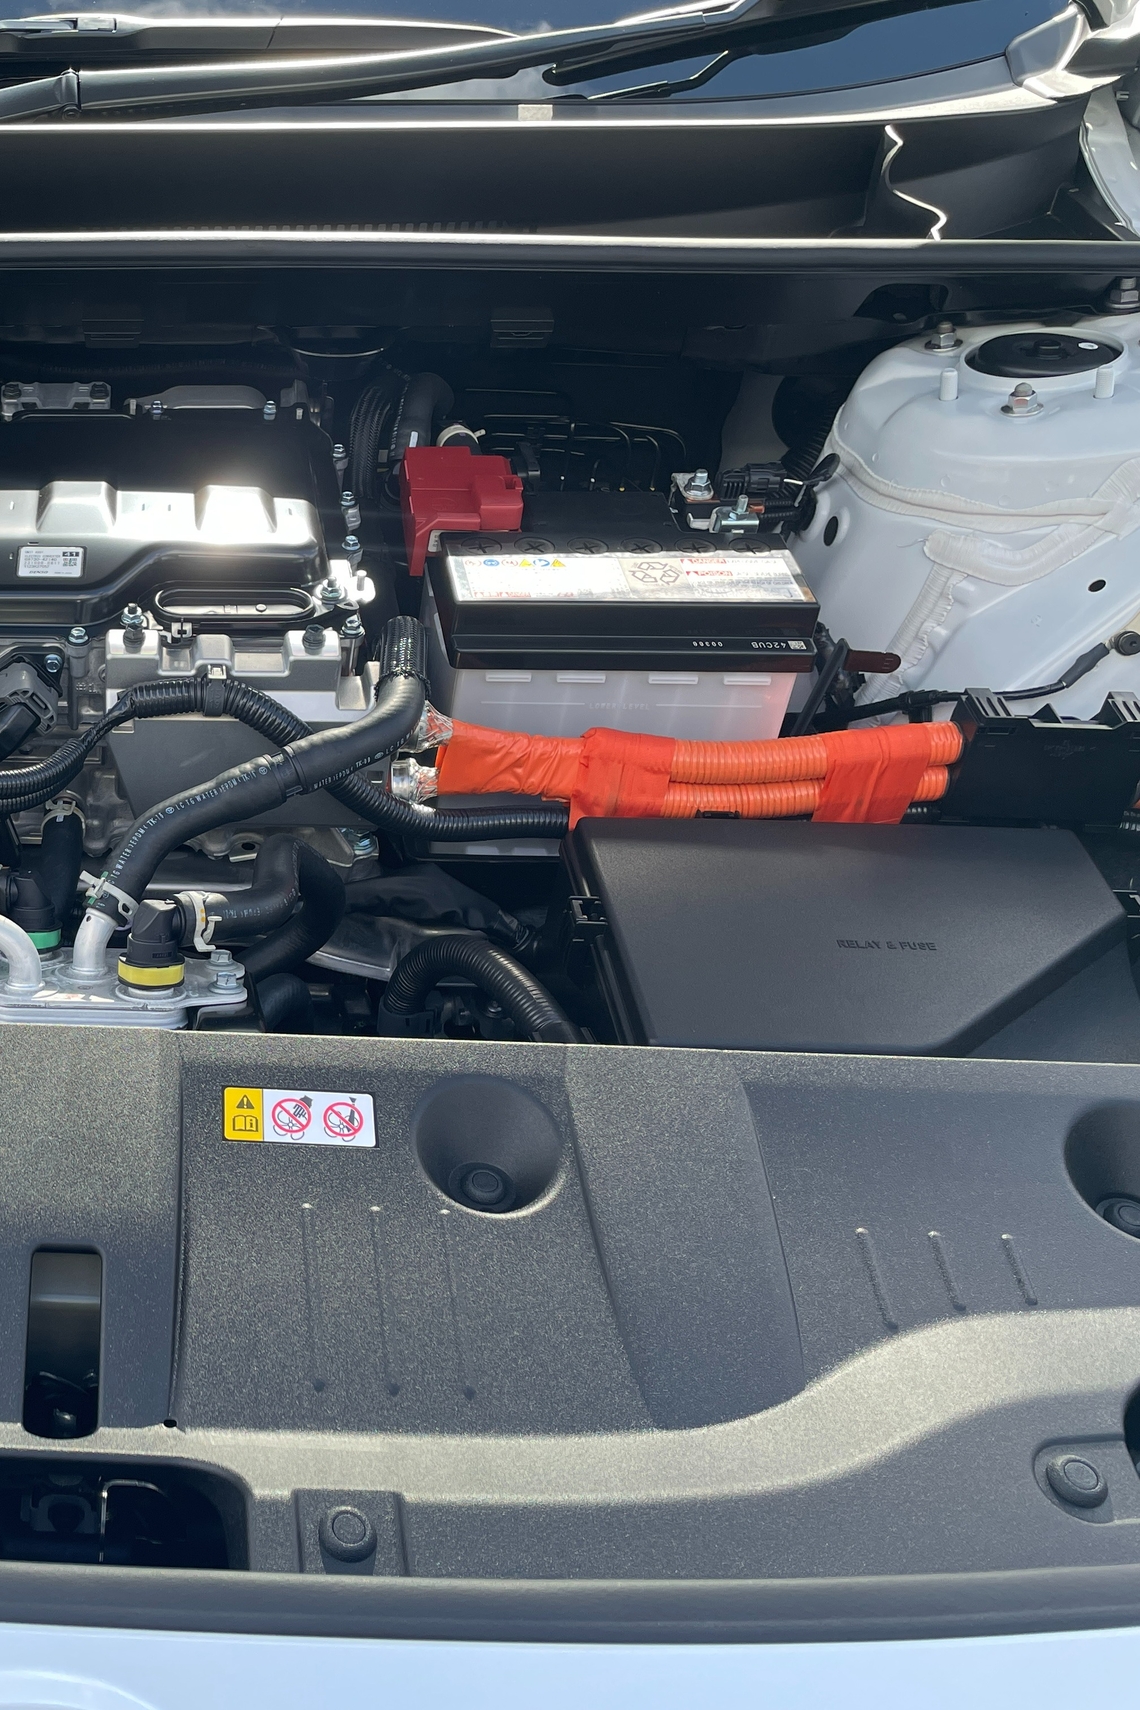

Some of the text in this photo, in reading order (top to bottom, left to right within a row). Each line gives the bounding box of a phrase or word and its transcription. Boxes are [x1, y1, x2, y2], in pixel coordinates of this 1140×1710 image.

[314, 776, 332, 789] WATER
[196, 789, 219, 802] WATER
[115, 848, 132, 869] WATER
[836, 940, 937, 950] RELAY & FUSE
